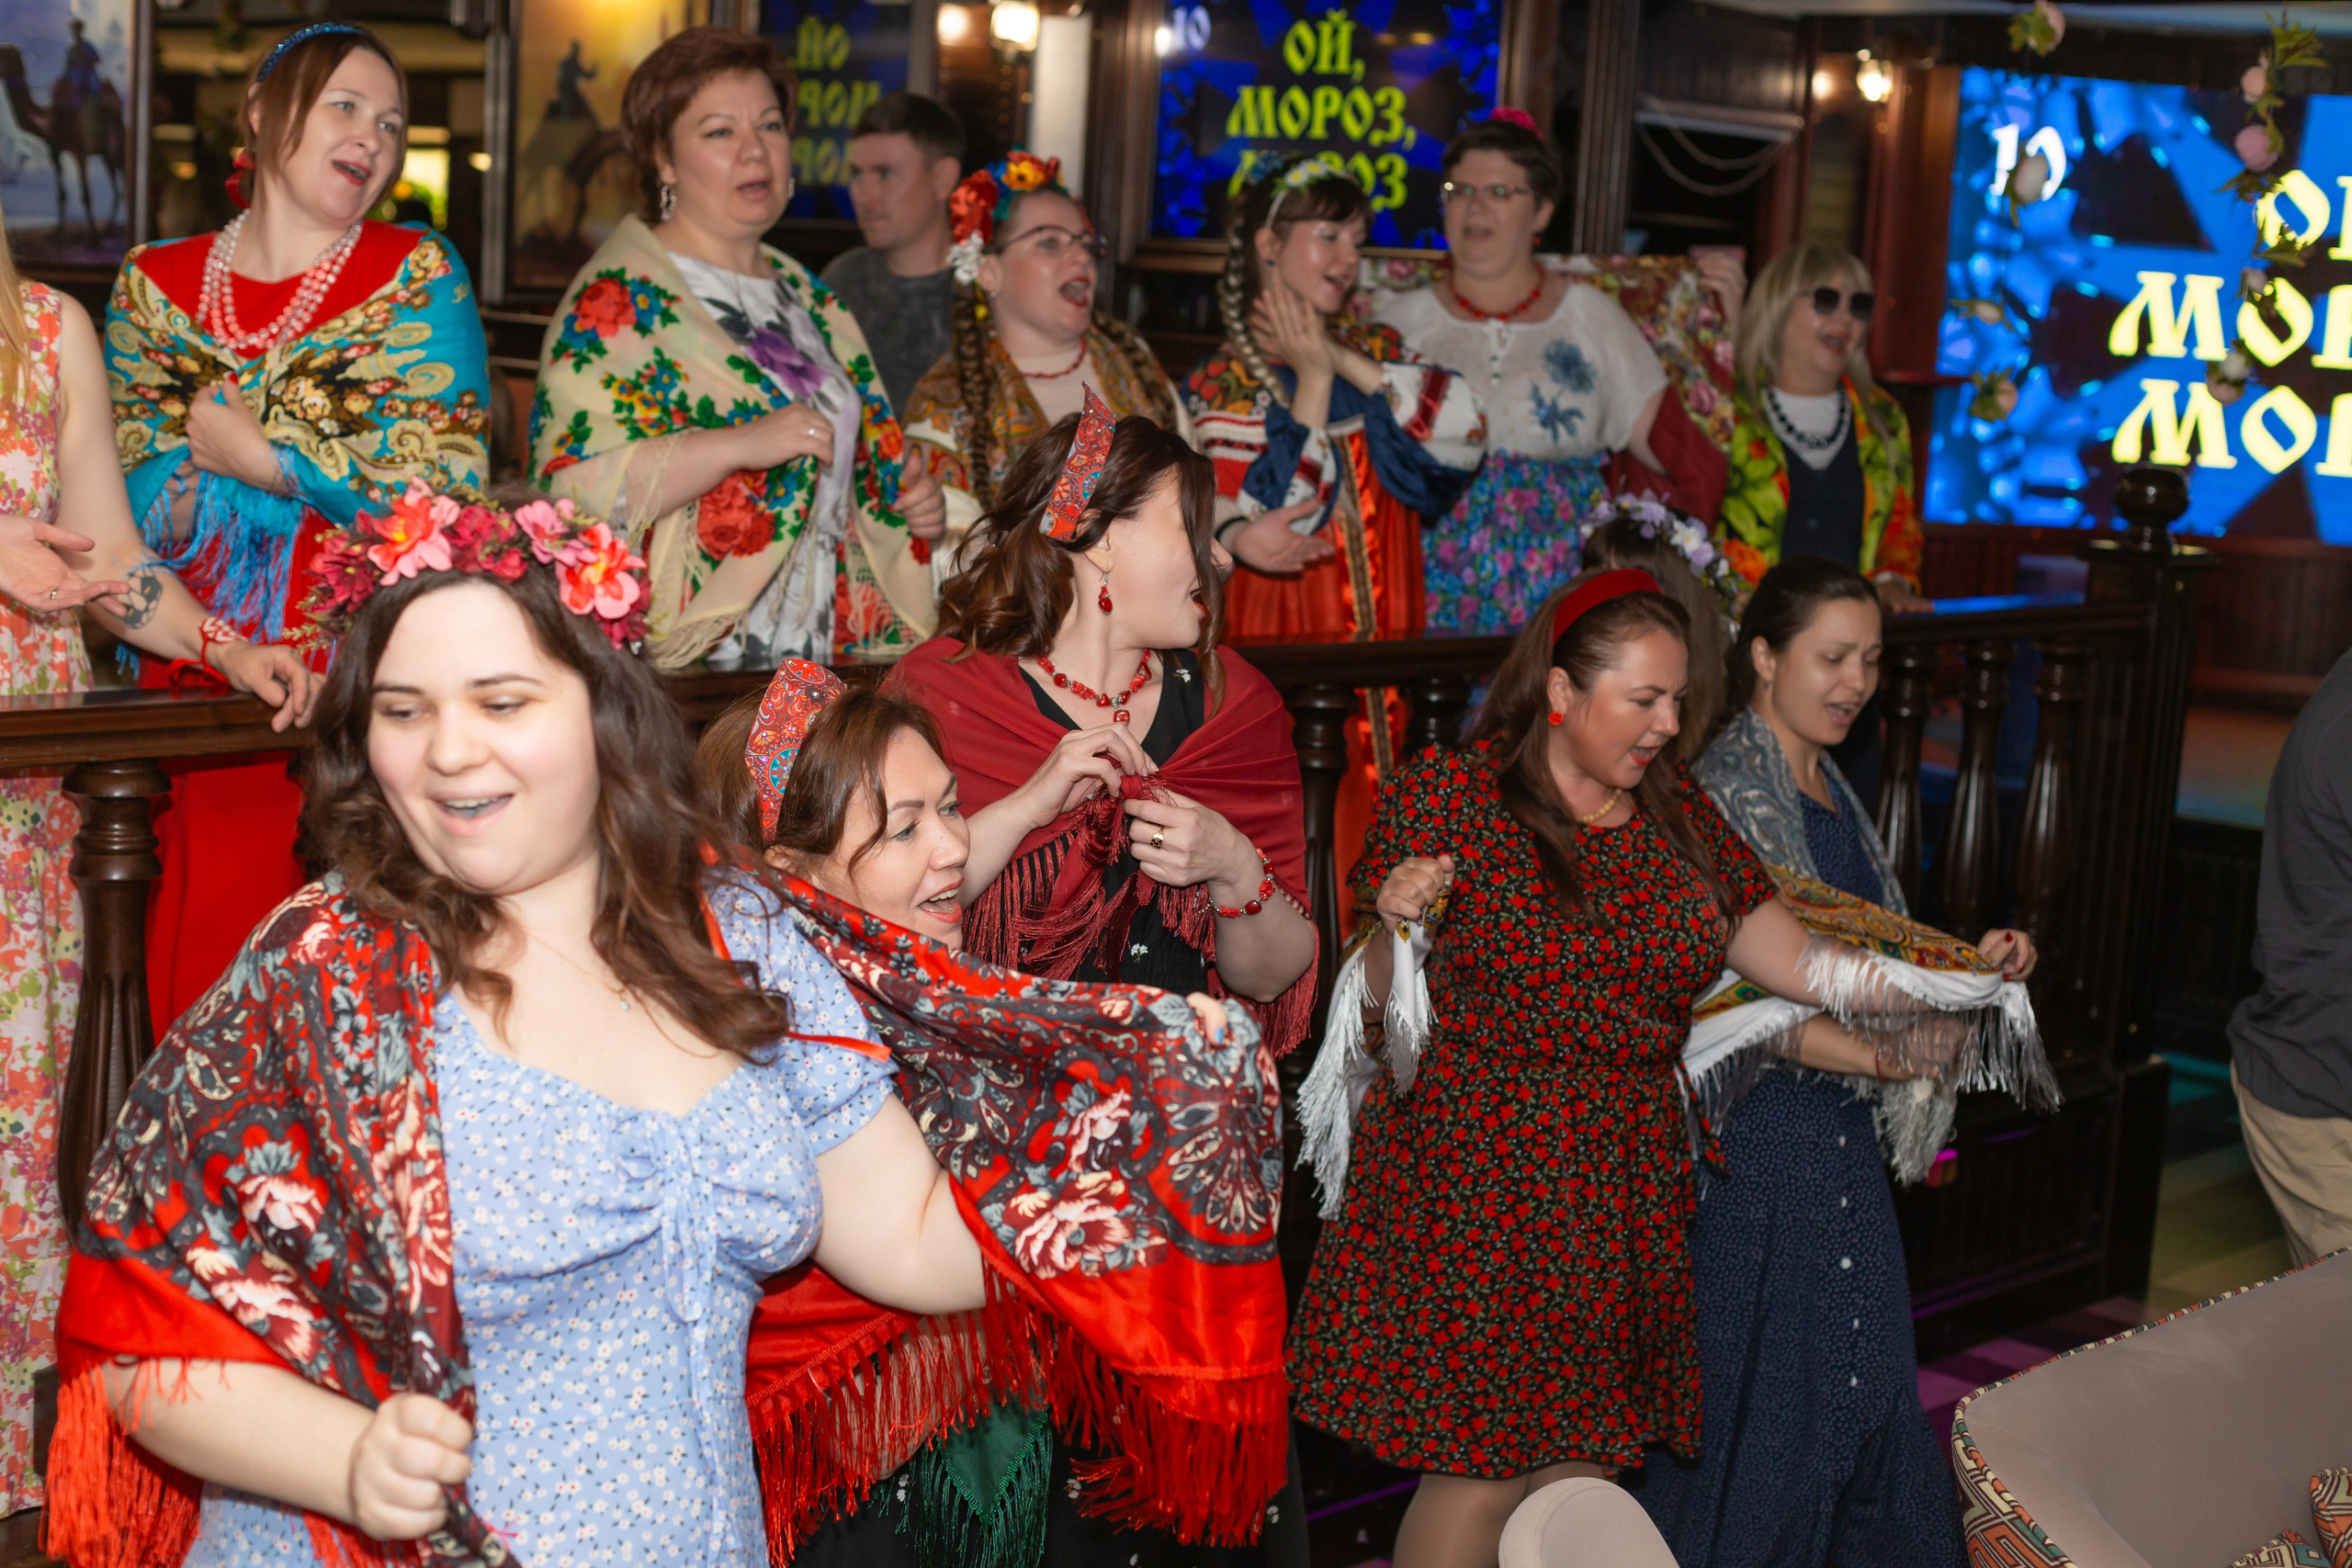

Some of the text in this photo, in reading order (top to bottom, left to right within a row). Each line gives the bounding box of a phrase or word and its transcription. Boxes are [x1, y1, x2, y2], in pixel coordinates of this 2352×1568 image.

[1171, 5, 1212, 51] 10
[1283, 8, 1366, 84] ОЙ,
[1226, 84, 1418, 151] МОРОЗ,
